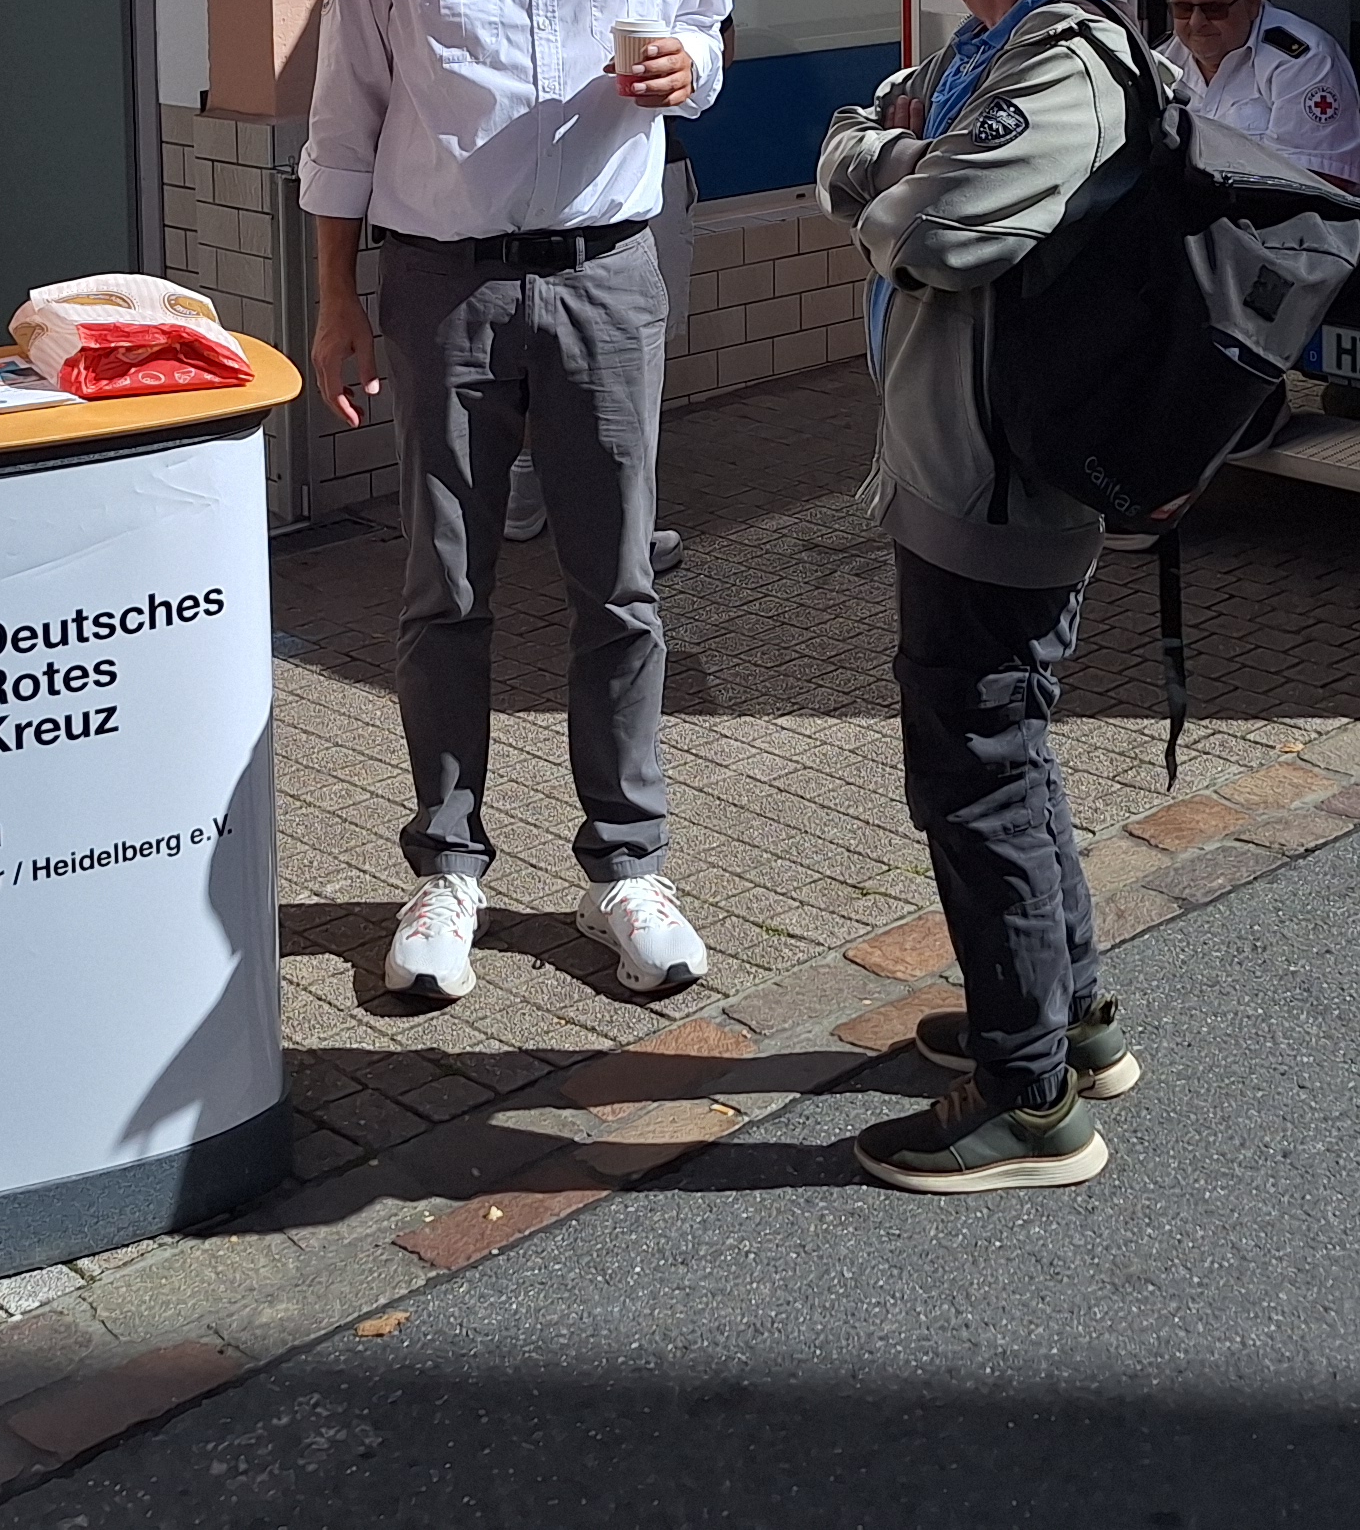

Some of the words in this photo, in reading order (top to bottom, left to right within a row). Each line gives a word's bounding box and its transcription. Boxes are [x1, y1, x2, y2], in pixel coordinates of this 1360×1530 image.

[1309, 350, 1318, 362] D
[12, 860, 23, 886] /
[32, 833, 181, 881] Heidelberg
[190, 813, 233, 845] e.V.
